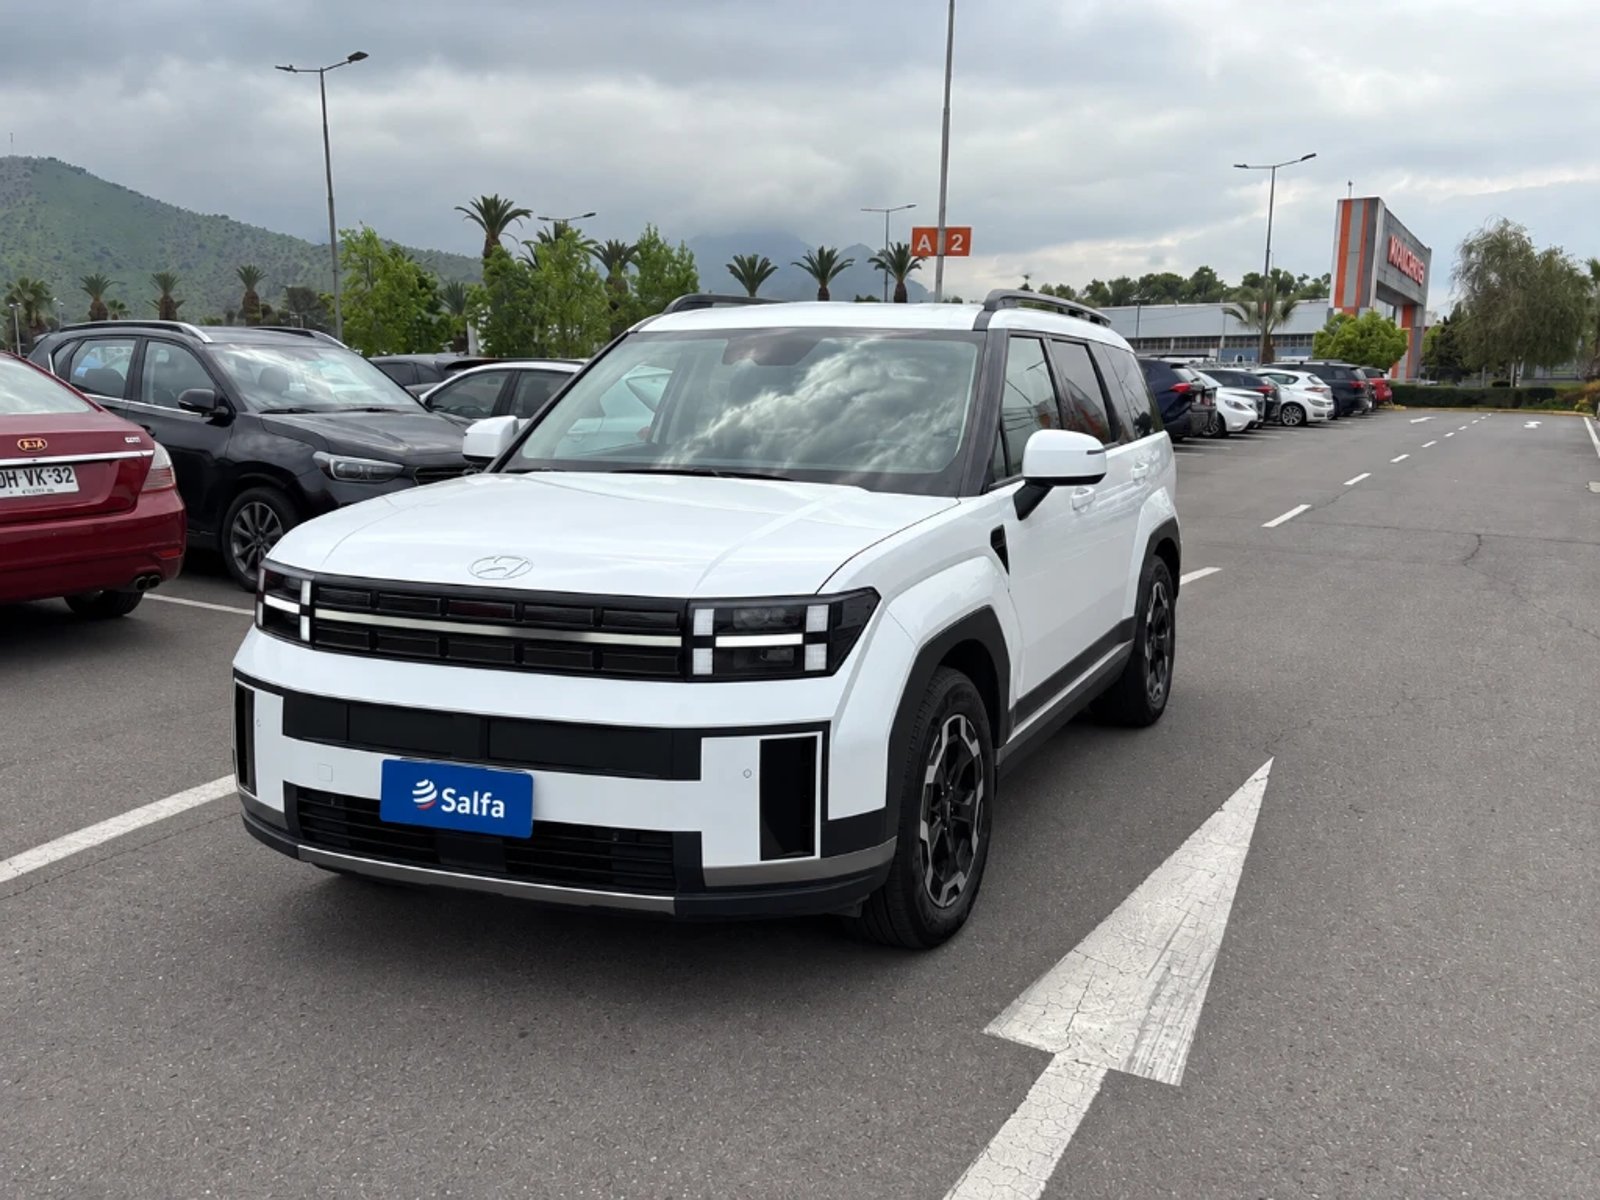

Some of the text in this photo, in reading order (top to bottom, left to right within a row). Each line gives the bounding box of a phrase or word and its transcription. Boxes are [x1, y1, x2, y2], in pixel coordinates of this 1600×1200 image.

[917, 234, 963, 252] A 2
[441, 787, 506, 819] Salfa
